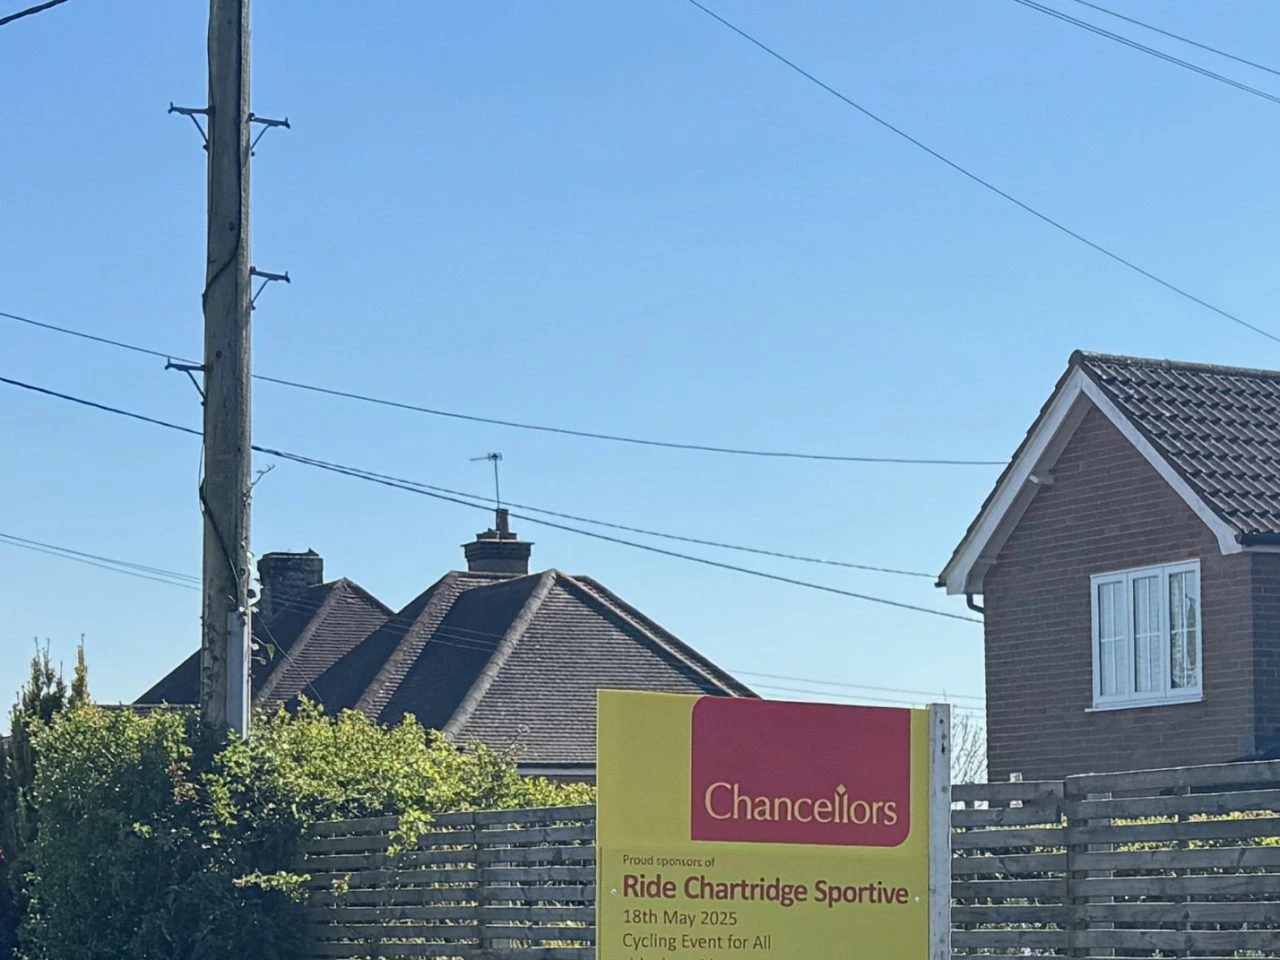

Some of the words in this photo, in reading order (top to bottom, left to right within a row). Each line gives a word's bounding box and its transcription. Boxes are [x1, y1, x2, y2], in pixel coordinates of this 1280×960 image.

[704, 782, 898, 825] Chancellors
[622, 854, 654, 867] Proud
[656, 857, 703, 868] sponsors
[704, 856, 716, 868] of
[622, 874, 676, 899] Ride
[683, 875, 808, 907] Chartridge
[814, 880, 909, 908] Sportive
[623, 909, 658, 925] 18th
[663, 910, 696, 928] May
[700, 911, 738, 926] 2025
[622, 932, 677, 951] Cycling
[682, 934, 722, 950] Event
[727, 934, 749, 950] for
[753, 934, 772, 951] All
